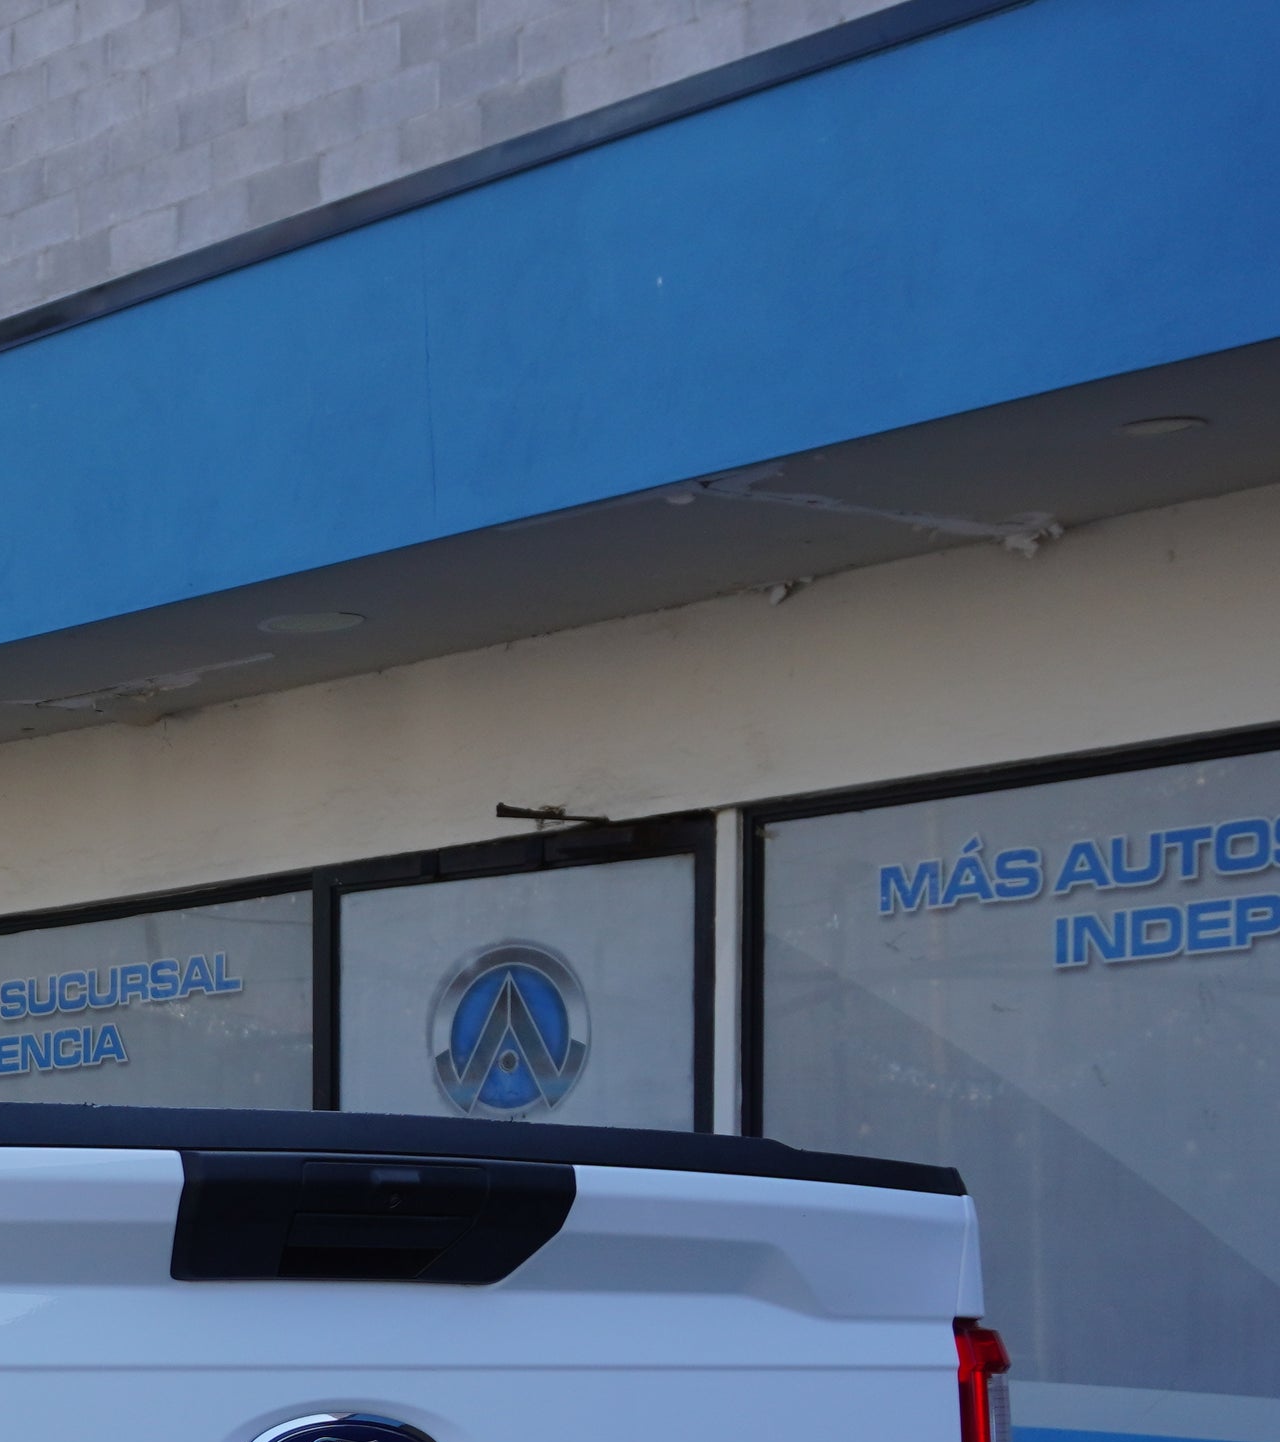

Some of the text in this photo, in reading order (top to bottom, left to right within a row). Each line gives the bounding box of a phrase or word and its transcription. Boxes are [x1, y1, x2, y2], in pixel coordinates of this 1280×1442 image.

[879, 815, 1280, 914] MÁS AUTO
[1054, 895, 1280, 968] INDEP
[0, 951, 243, 1020] SUCURSAL
